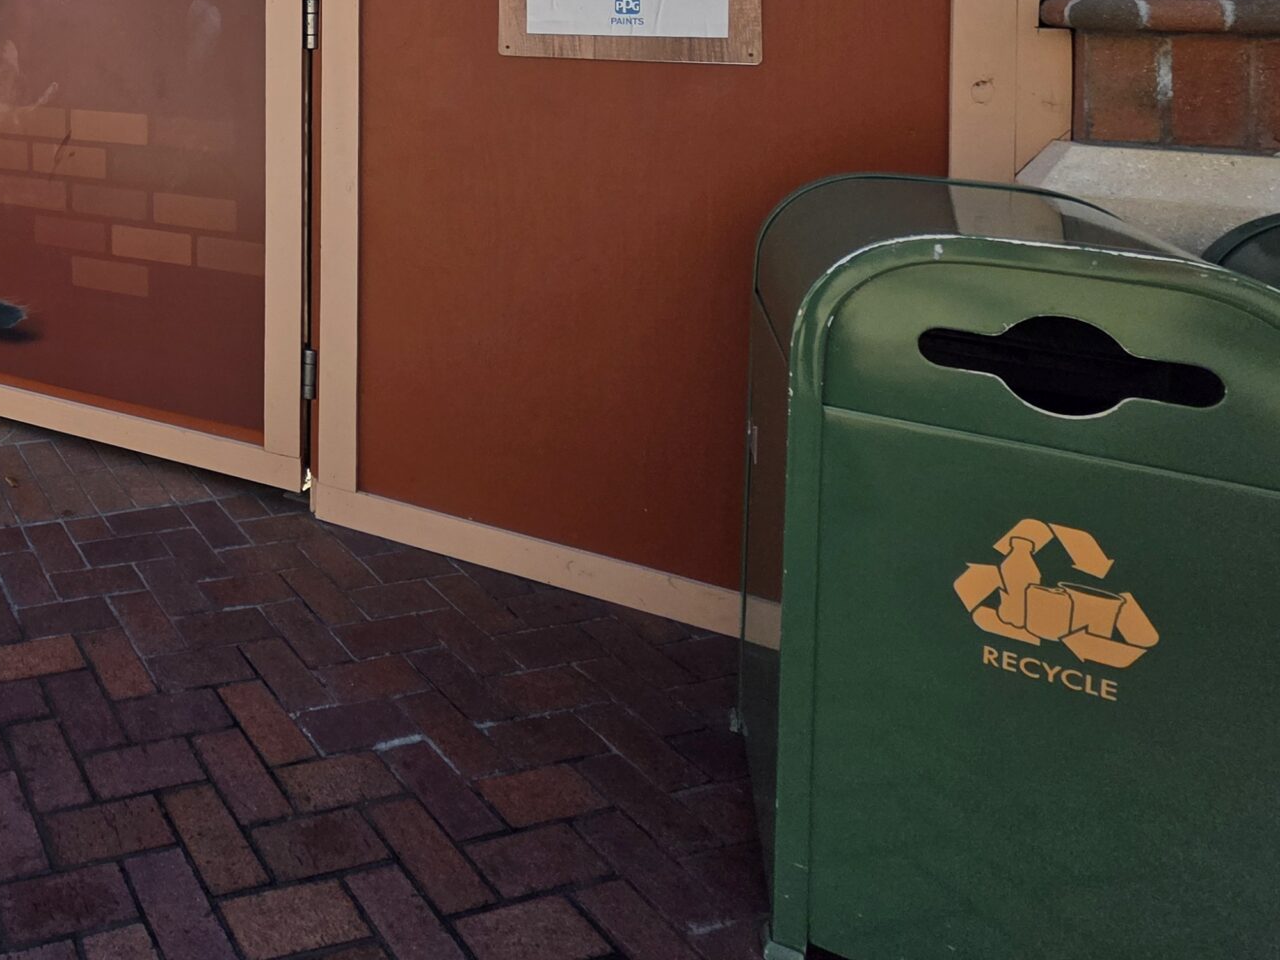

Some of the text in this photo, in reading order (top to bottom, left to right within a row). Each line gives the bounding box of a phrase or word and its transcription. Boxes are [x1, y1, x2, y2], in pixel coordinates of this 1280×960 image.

[615, 0, 640, 13] PPG
[610, 17, 645, 26] PAINTS
[982, 645, 1118, 701] RECYCLE
